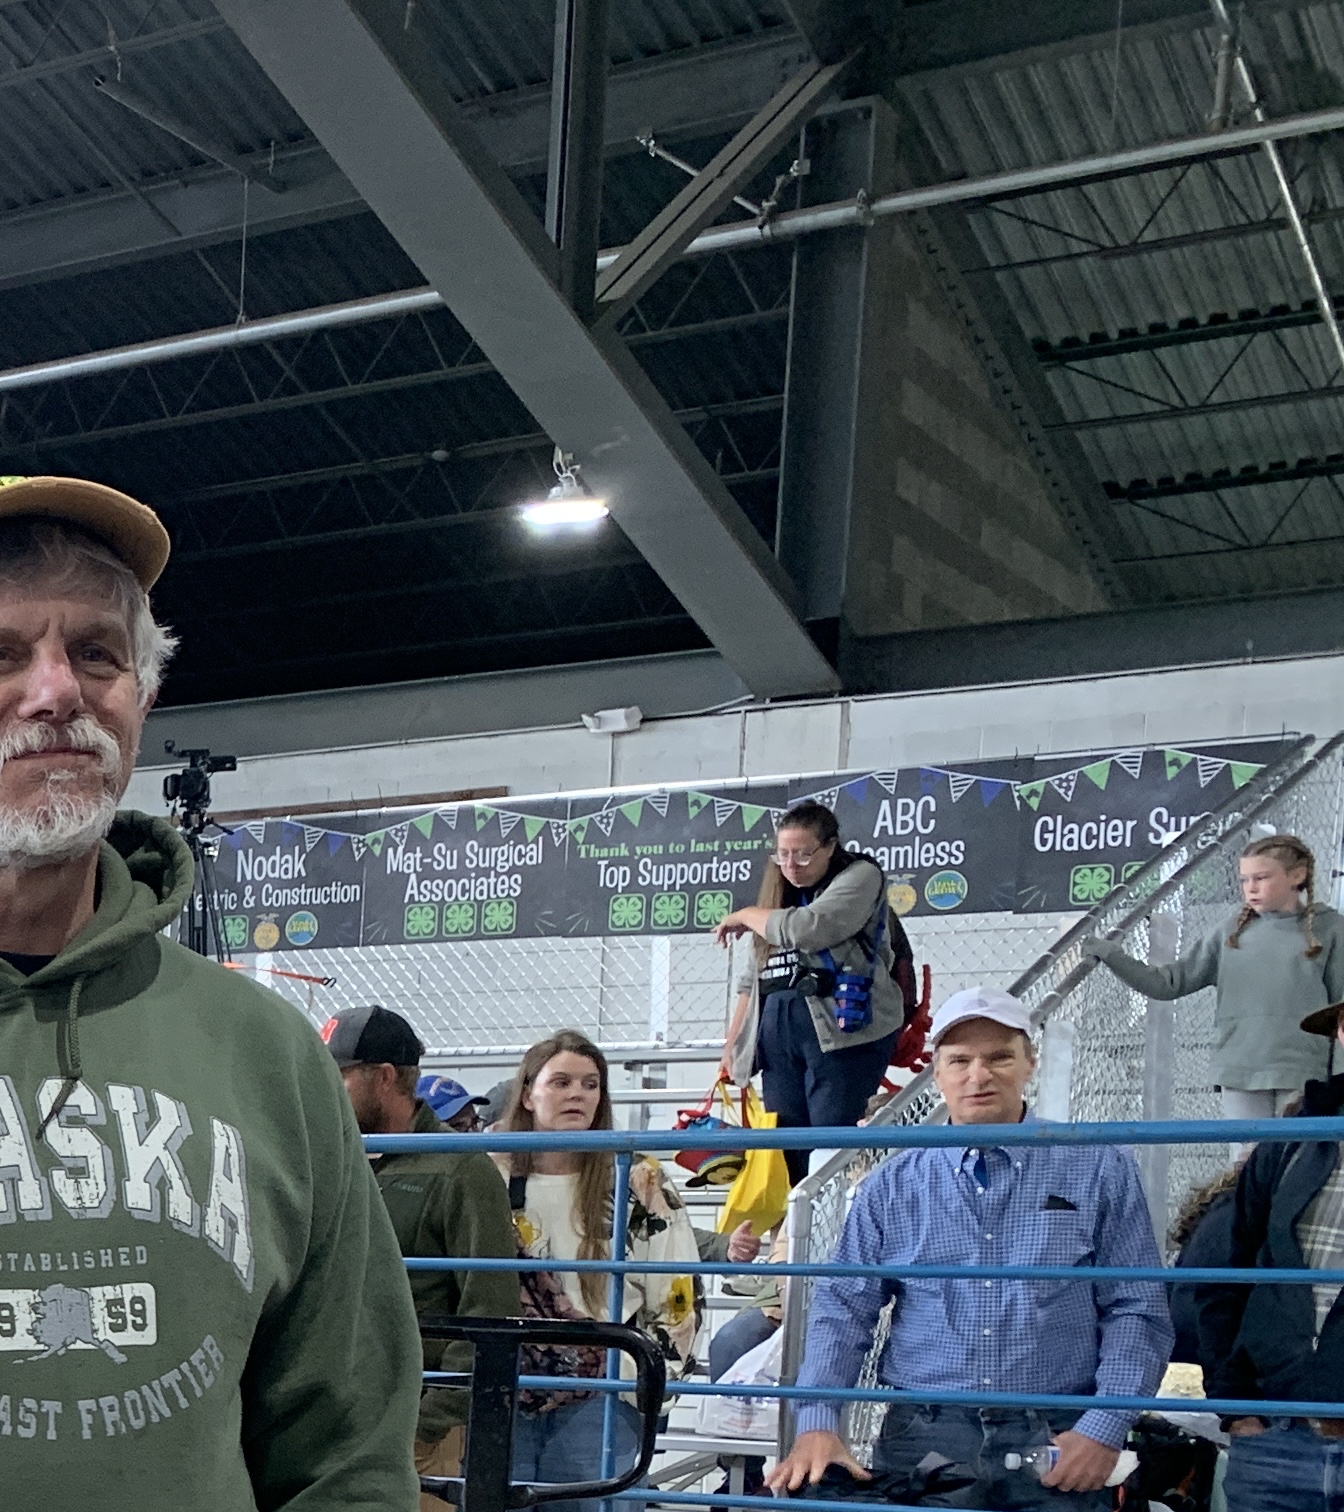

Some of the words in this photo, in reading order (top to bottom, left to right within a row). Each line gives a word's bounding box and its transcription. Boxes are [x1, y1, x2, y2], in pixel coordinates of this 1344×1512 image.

[873, 795, 937, 838] ABC
[1033, 813, 1138, 852] Glacier
[236, 845, 307, 883] Nodak
[386, 840, 458, 875] Mat-Su
[465, 835, 543, 873] Surgical
[577, 839, 630, 859] Thank
[634, 841, 663, 860] you
[668, 841, 685, 854] to
[690, 838, 721, 853] last
[724, 833, 774, 853] year's
[844, 836, 966, 871] amless
[404, 872, 522, 903] Associates
[597, 860, 631, 893] Top
[638, 857, 752, 891] Supporters
[243, 884, 257, 909] &
[262, 880, 361, 907] Construction
[105, 1295, 148, 1334] 59
[76, 1334, 227, 1440] FRONTIER
